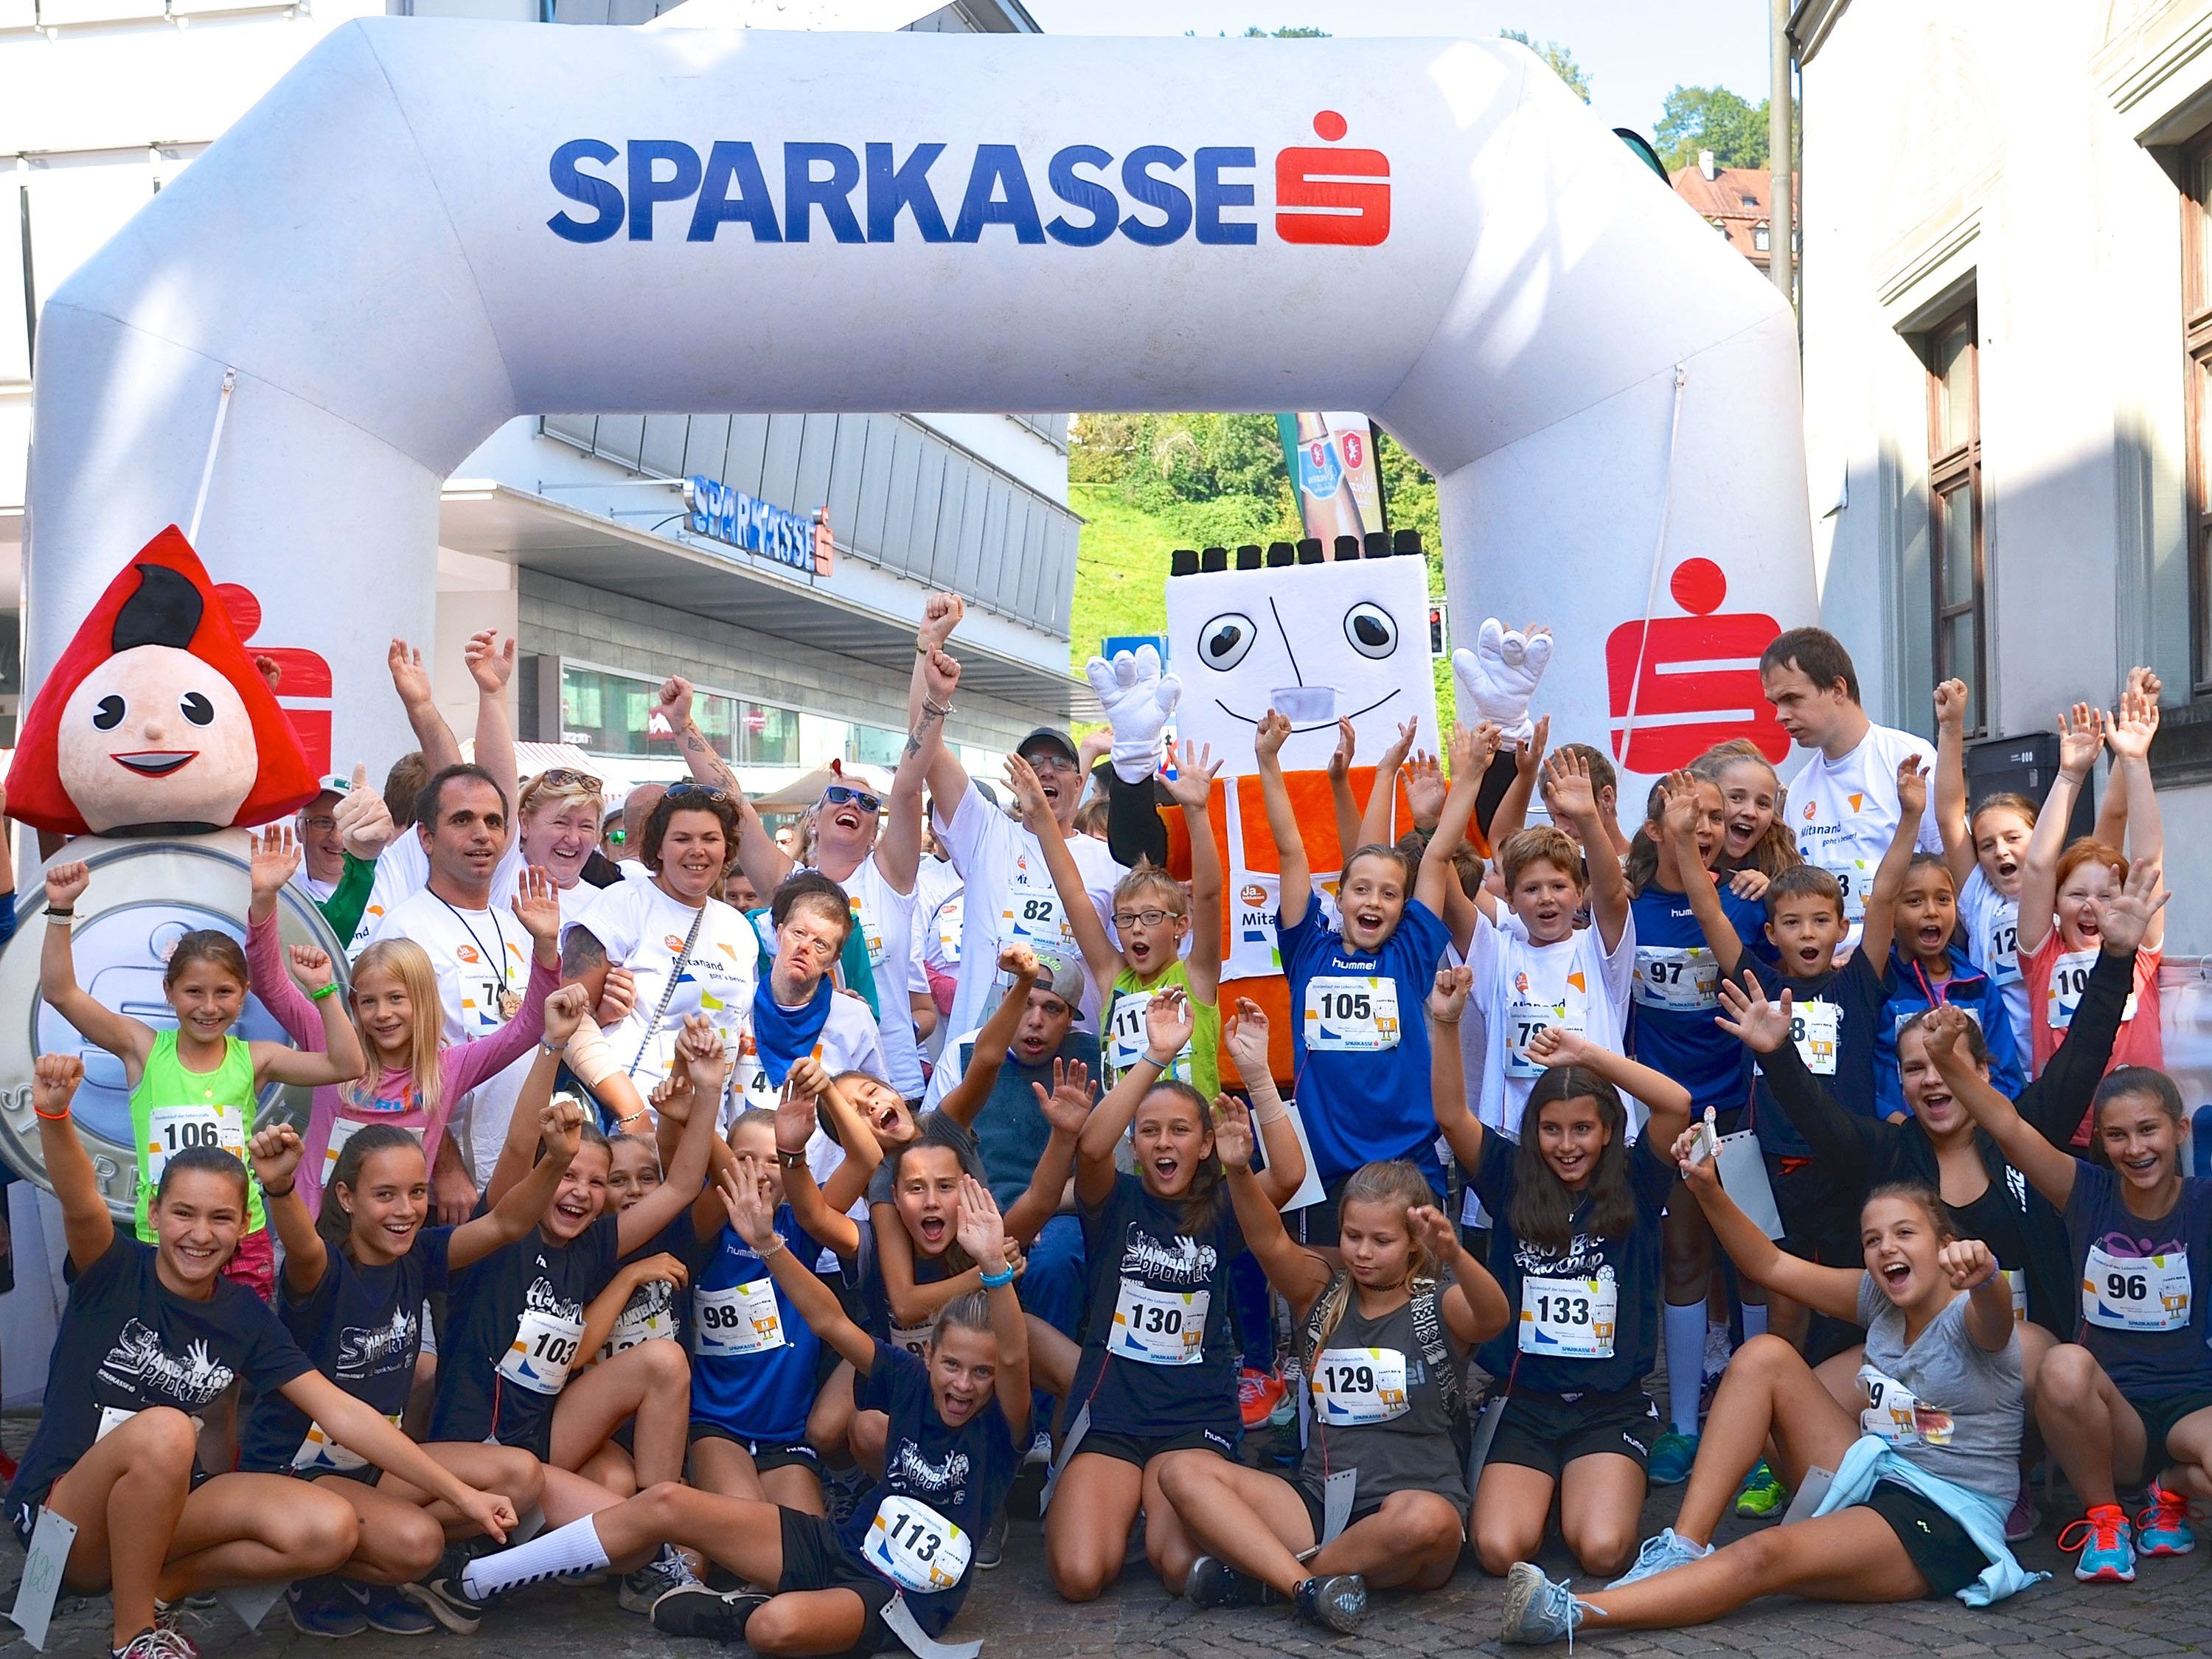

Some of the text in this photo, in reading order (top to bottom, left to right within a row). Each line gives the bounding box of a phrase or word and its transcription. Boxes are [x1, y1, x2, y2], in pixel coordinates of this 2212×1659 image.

[546, 137, 1258, 246] SPARKASSE
[684, 476, 815, 572] SPARKASSE
[1837, 874, 1849, 897] 3
[1023, 900, 1052, 922] 82
[1242, 912, 1276, 925] Mita
[1672, 908, 1693, 917] hum
[1993, 928, 2016, 955] 12
[1037, 954, 1062, 971] CAGO
[1332, 957, 1376, 970] hummel
[1651, 962, 1683, 984] 97
[2058, 969, 2087, 995] 10
[1321, 993, 1371, 1019] 105
[1116, 1009, 1146, 1037] 11
[1789, 1018, 1806, 1042] 8
[164, 1122, 218, 1150] 106
[2107, 1273, 2146, 1300] 96
[703, 1305, 739, 1329] 98
[1132, 1304, 1182, 1335] 130
[1537, 1295, 1589, 1325] 133
[534, 1333, 578, 1366] 103
[728, 1343, 755, 1351] SPARKASSE
[97, 1368, 131, 1391] SPARKASSE
[140, 1346, 205, 1388] HANDBALL
[1325, 1366, 1374, 1393] 129
[891, 1513, 941, 1561] 113
[893, 1571, 919, 1588] SPARKASSE
